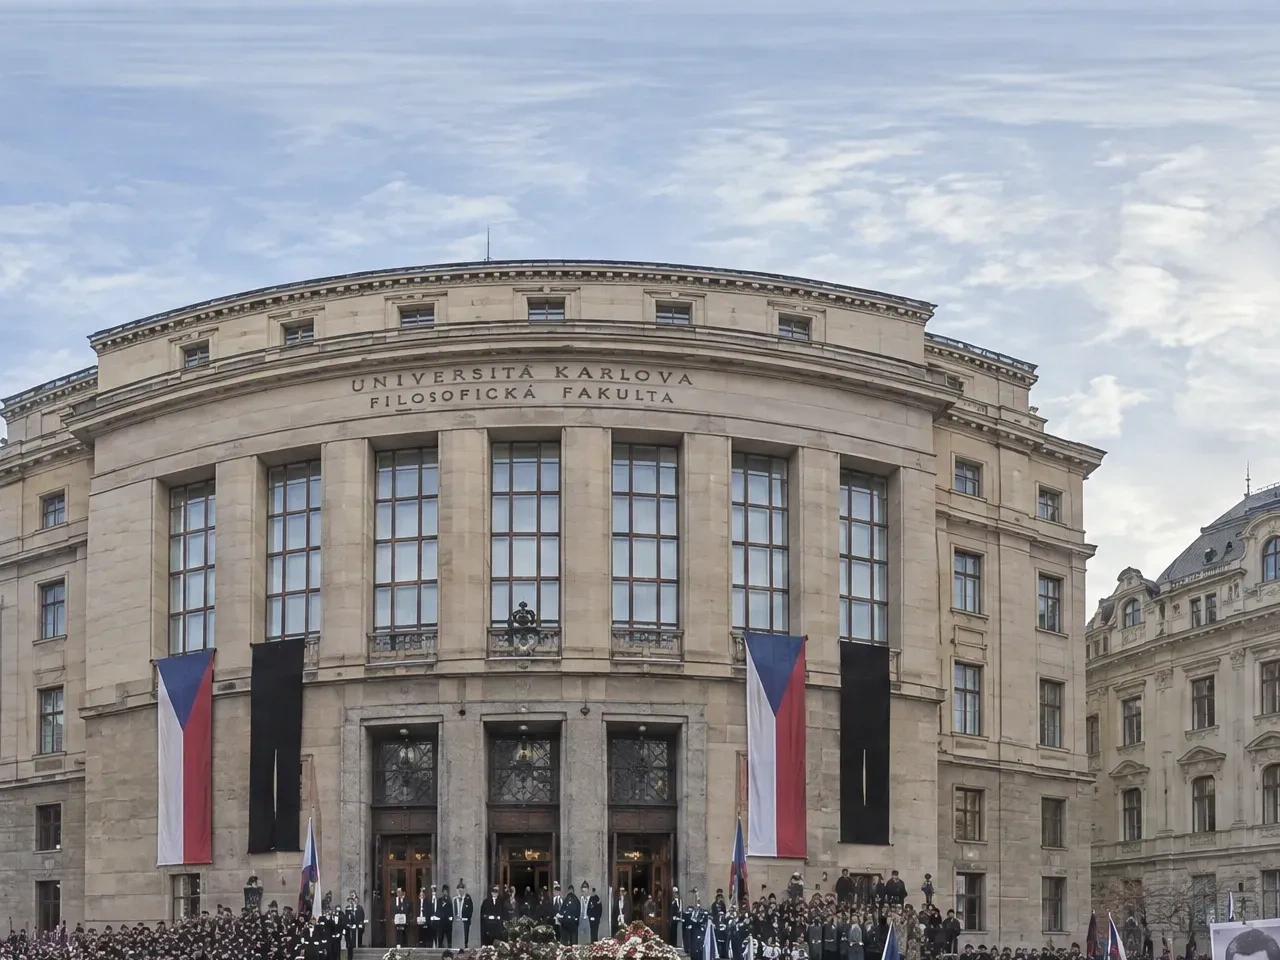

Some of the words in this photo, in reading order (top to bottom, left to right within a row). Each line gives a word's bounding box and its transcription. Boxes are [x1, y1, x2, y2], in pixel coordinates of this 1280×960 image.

[554, 366, 694, 387] KARLOVA
[370, 384, 538, 409] FILOSOFICKÁ
[562, 386, 675, 404] FAKULTA
